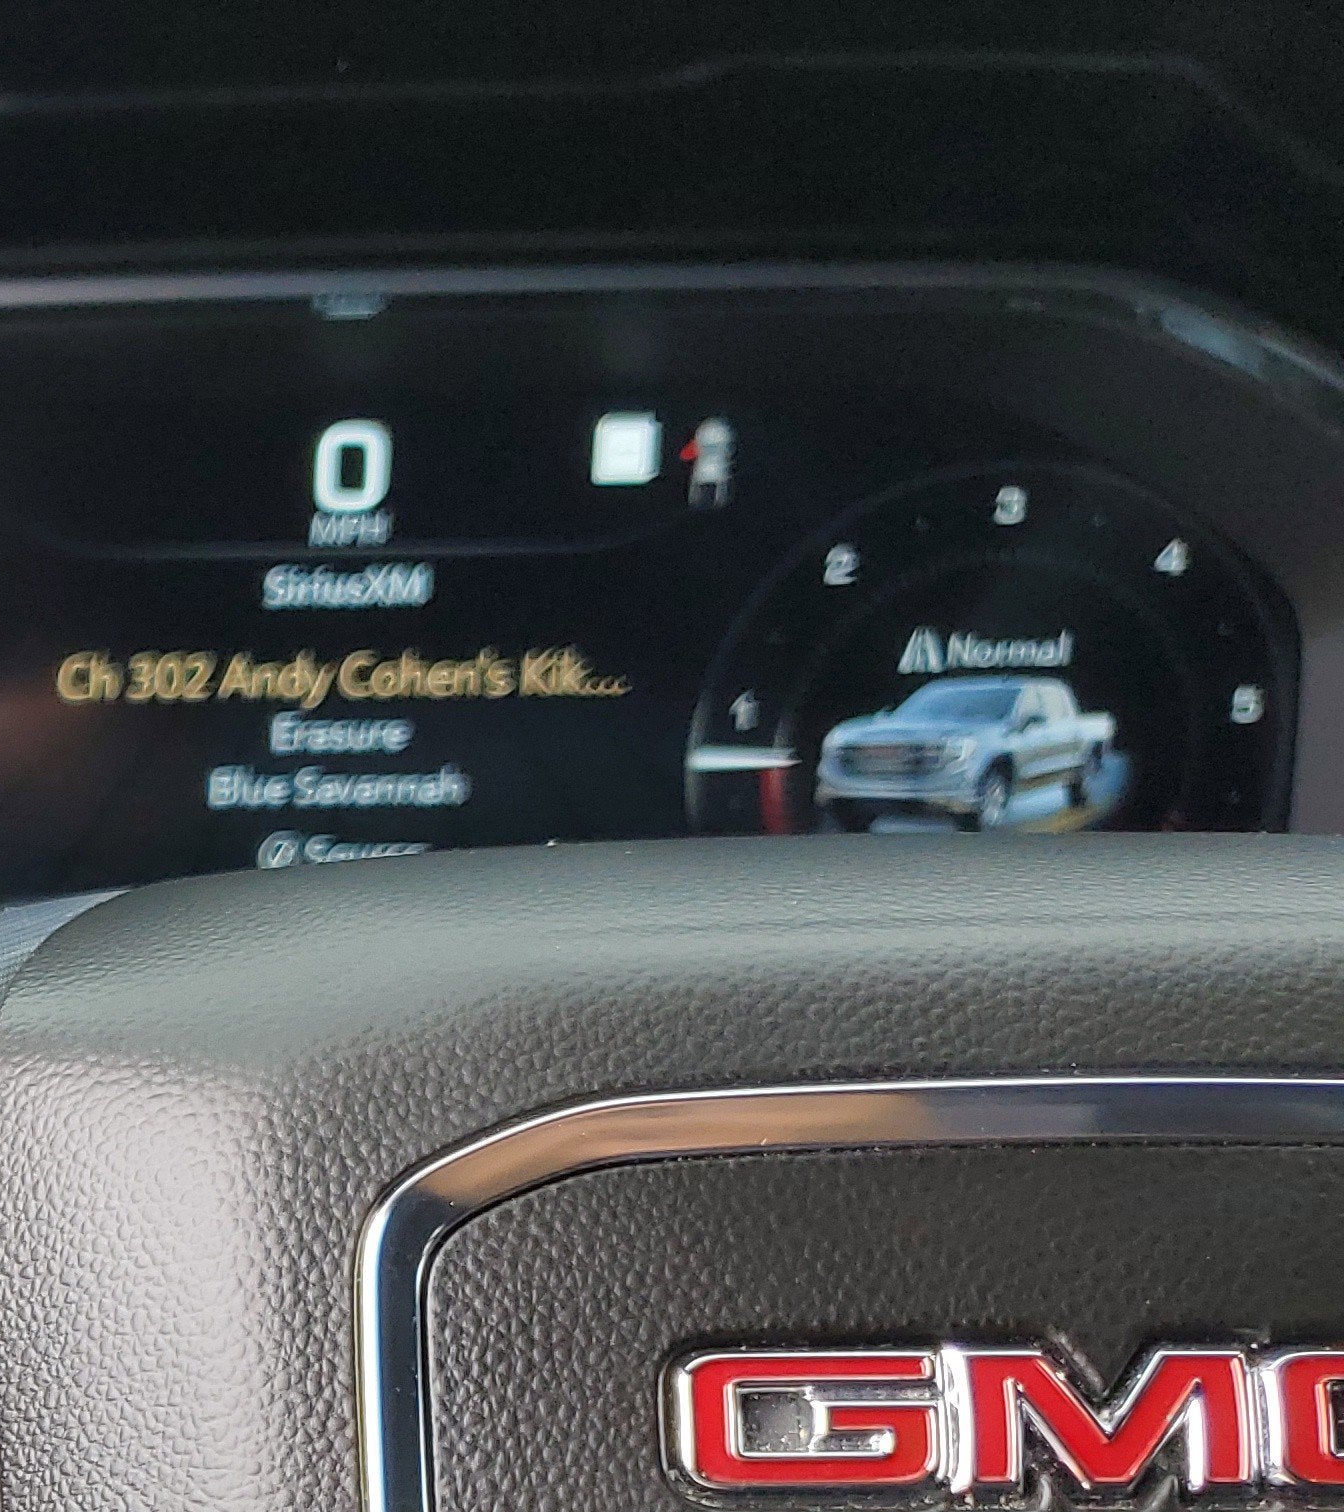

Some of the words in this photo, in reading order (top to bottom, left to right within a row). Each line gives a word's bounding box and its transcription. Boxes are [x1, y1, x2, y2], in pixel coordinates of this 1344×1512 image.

[314, 420, 393, 514] 0
[992, 485, 1028, 525] 3
[823, 543, 860, 585] 2
[1153, 537, 1189, 577] 4
[262, 563, 434, 608] SiriusXM
[948, 628, 1074, 668] Normal
[57, 651, 123, 700] Ch
[125, 651, 216, 700] 302
[217, 650, 335, 708] Andy
[338, 648, 516, 700] Cohen's
[270, 711, 412, 753] Erasure
[208, 765, 293, 808] Blue
[295, 763, 471, 808] Savannah
[663, 1346, 1344, 1500] GM
